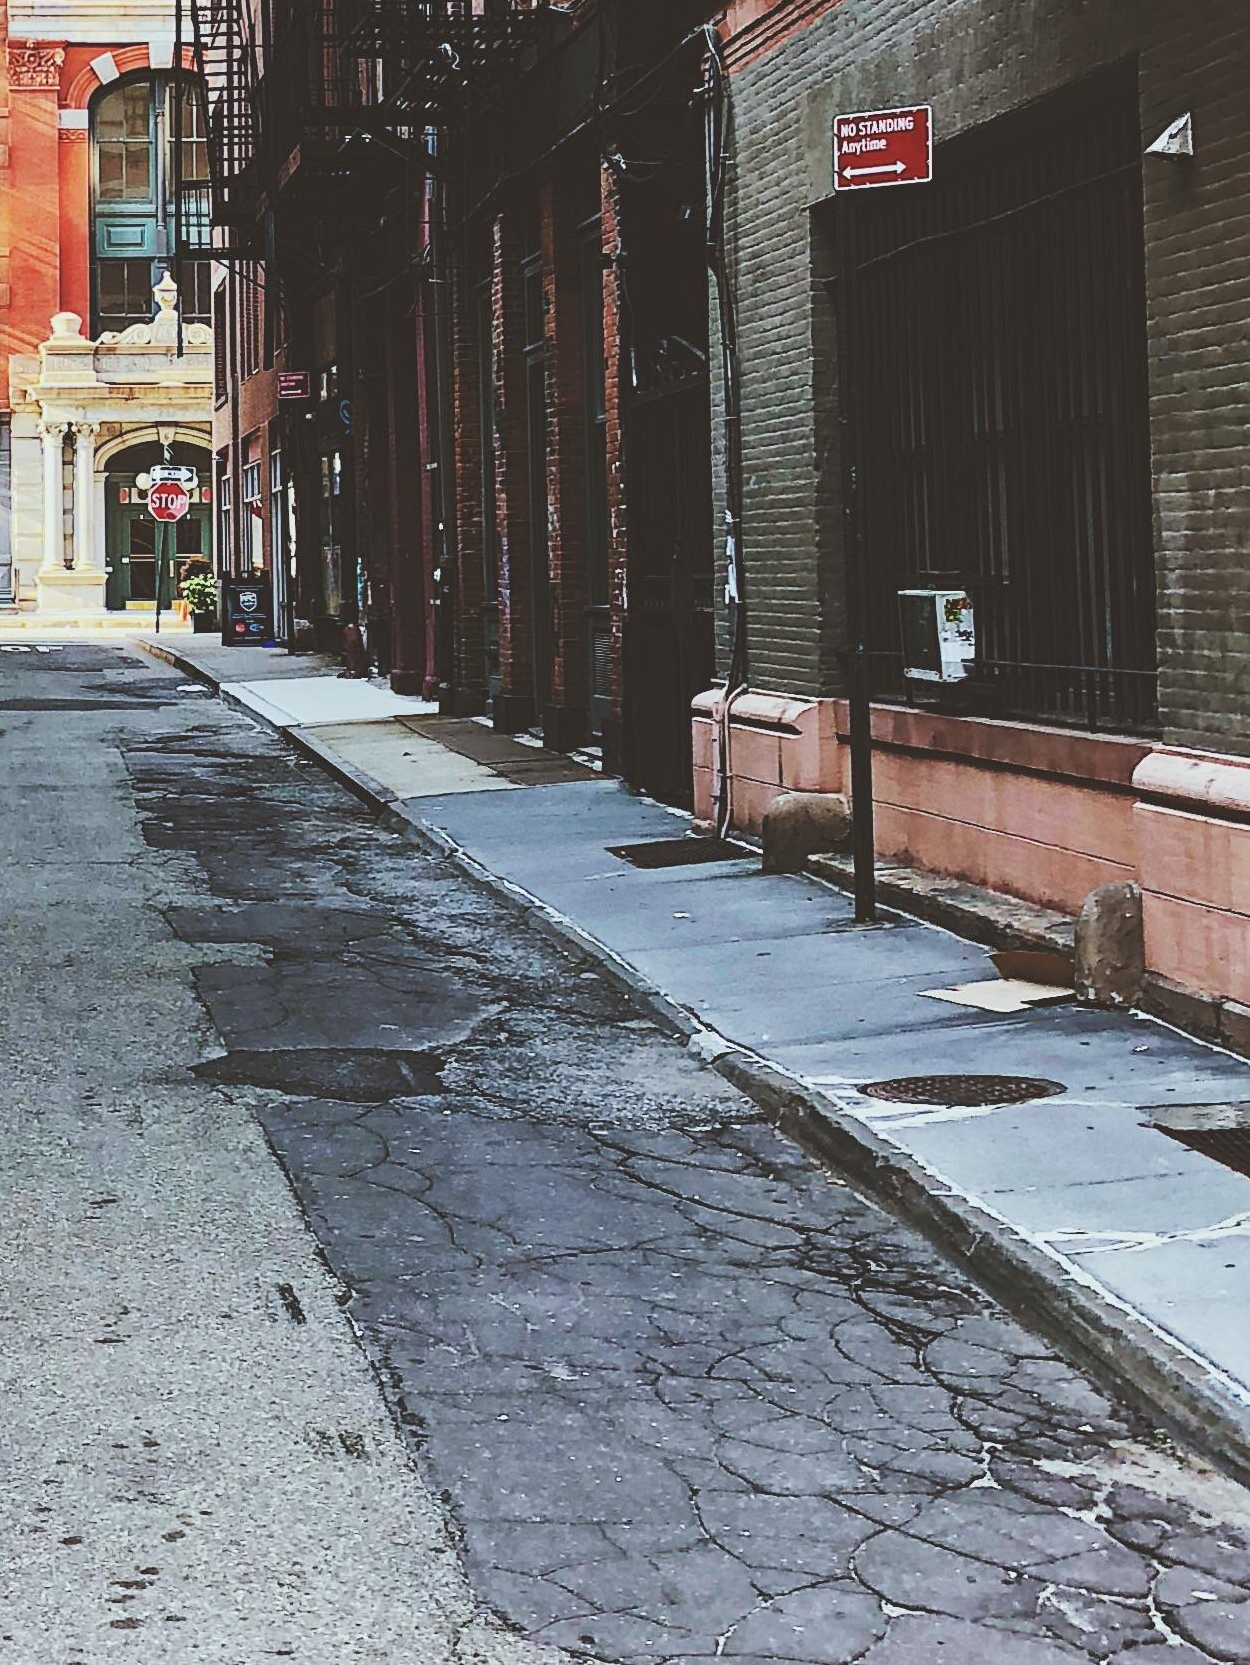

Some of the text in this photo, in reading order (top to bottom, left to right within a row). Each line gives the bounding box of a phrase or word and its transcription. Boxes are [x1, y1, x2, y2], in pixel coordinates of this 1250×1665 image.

[840, 117, 914, 137] NO STANDING
[841, 138, 887, 155] Anytime
[151, 493, 187, 509] STOP
